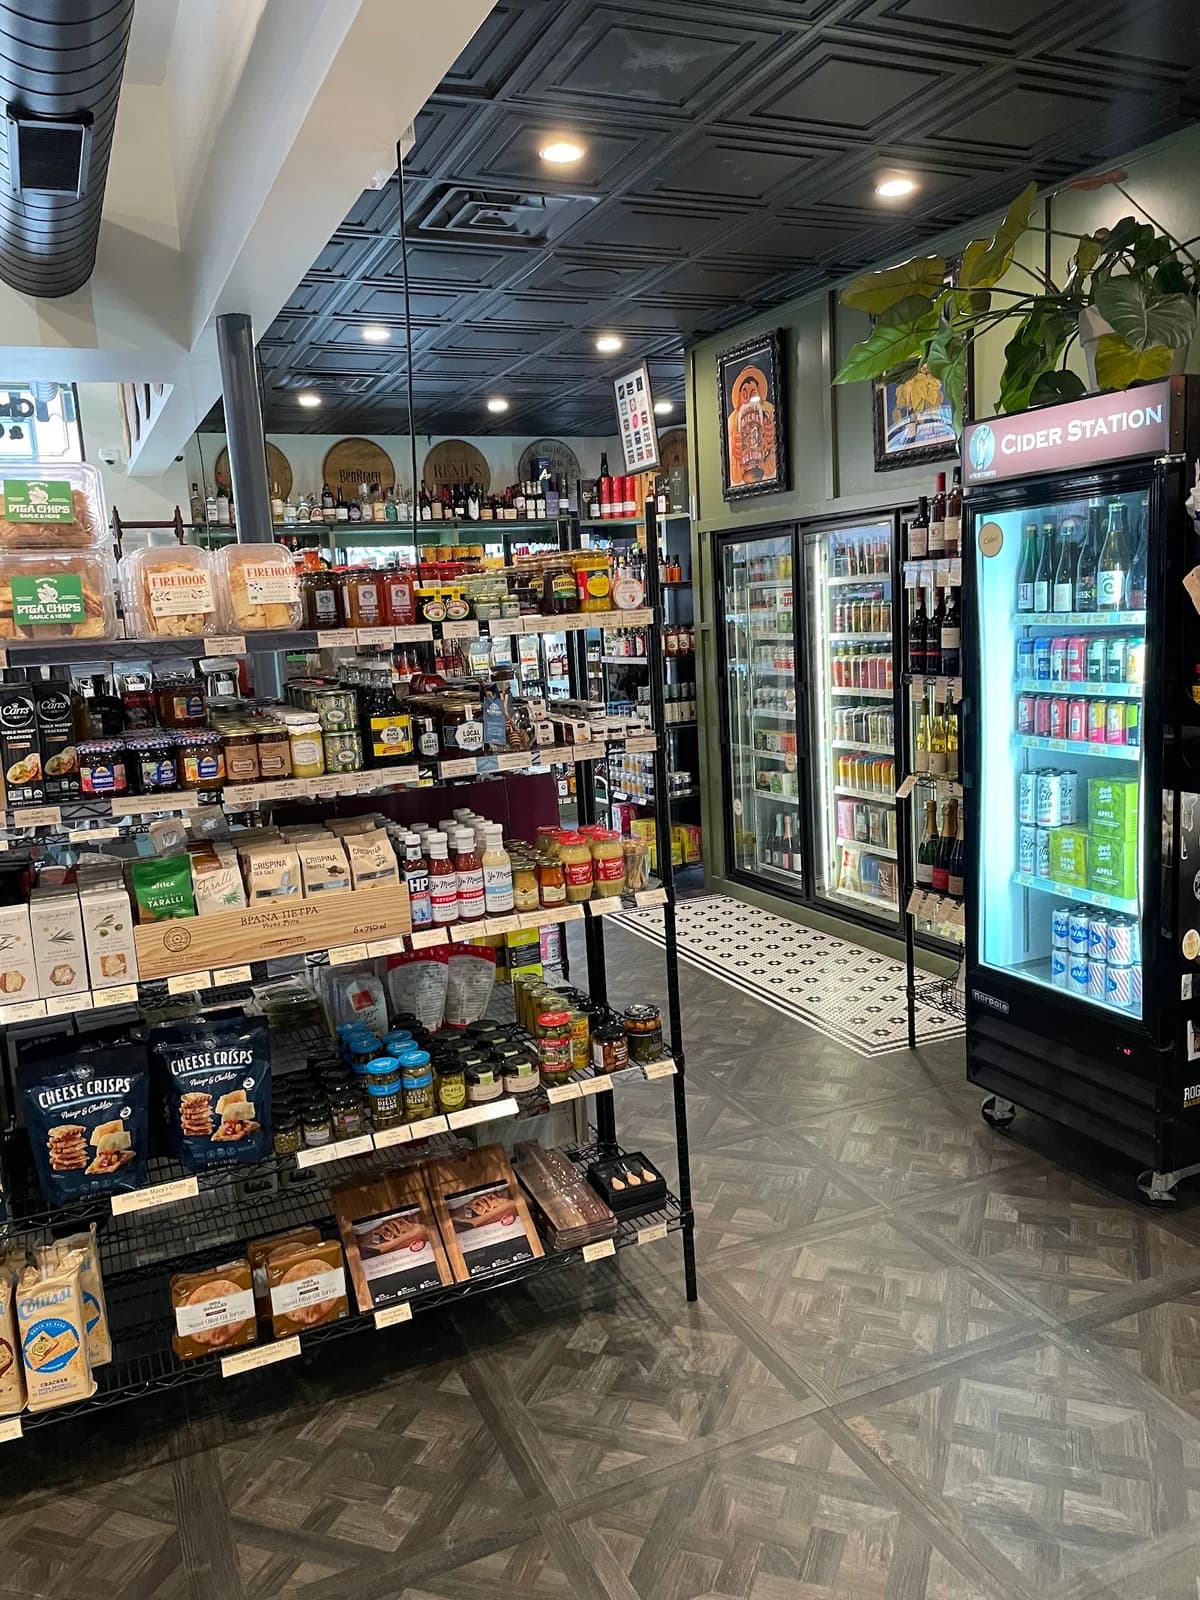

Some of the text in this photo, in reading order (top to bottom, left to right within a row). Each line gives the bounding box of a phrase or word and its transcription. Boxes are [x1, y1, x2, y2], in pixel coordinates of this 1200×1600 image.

[1001, 404, 1162, 455] CIDER STATION
[152, 574, 207, 588] FIREHOOK
[462, 729, 481, 737] LOCAL
[252, 859, 287, 870] CRISPINA
[305, 854, 338, 864] CRISPINA
[408, 877, 429, 893] HP
[147, 895, 184, 908] TARALLI
[170, 1048, 254, 1076] CHEESE CRISPS
[38, 1077, 131, 1109] CHEESE CRISPS
[298, 1294, 312, 1303] Olive
[40, 1377, 68, 1388] CRACKER
